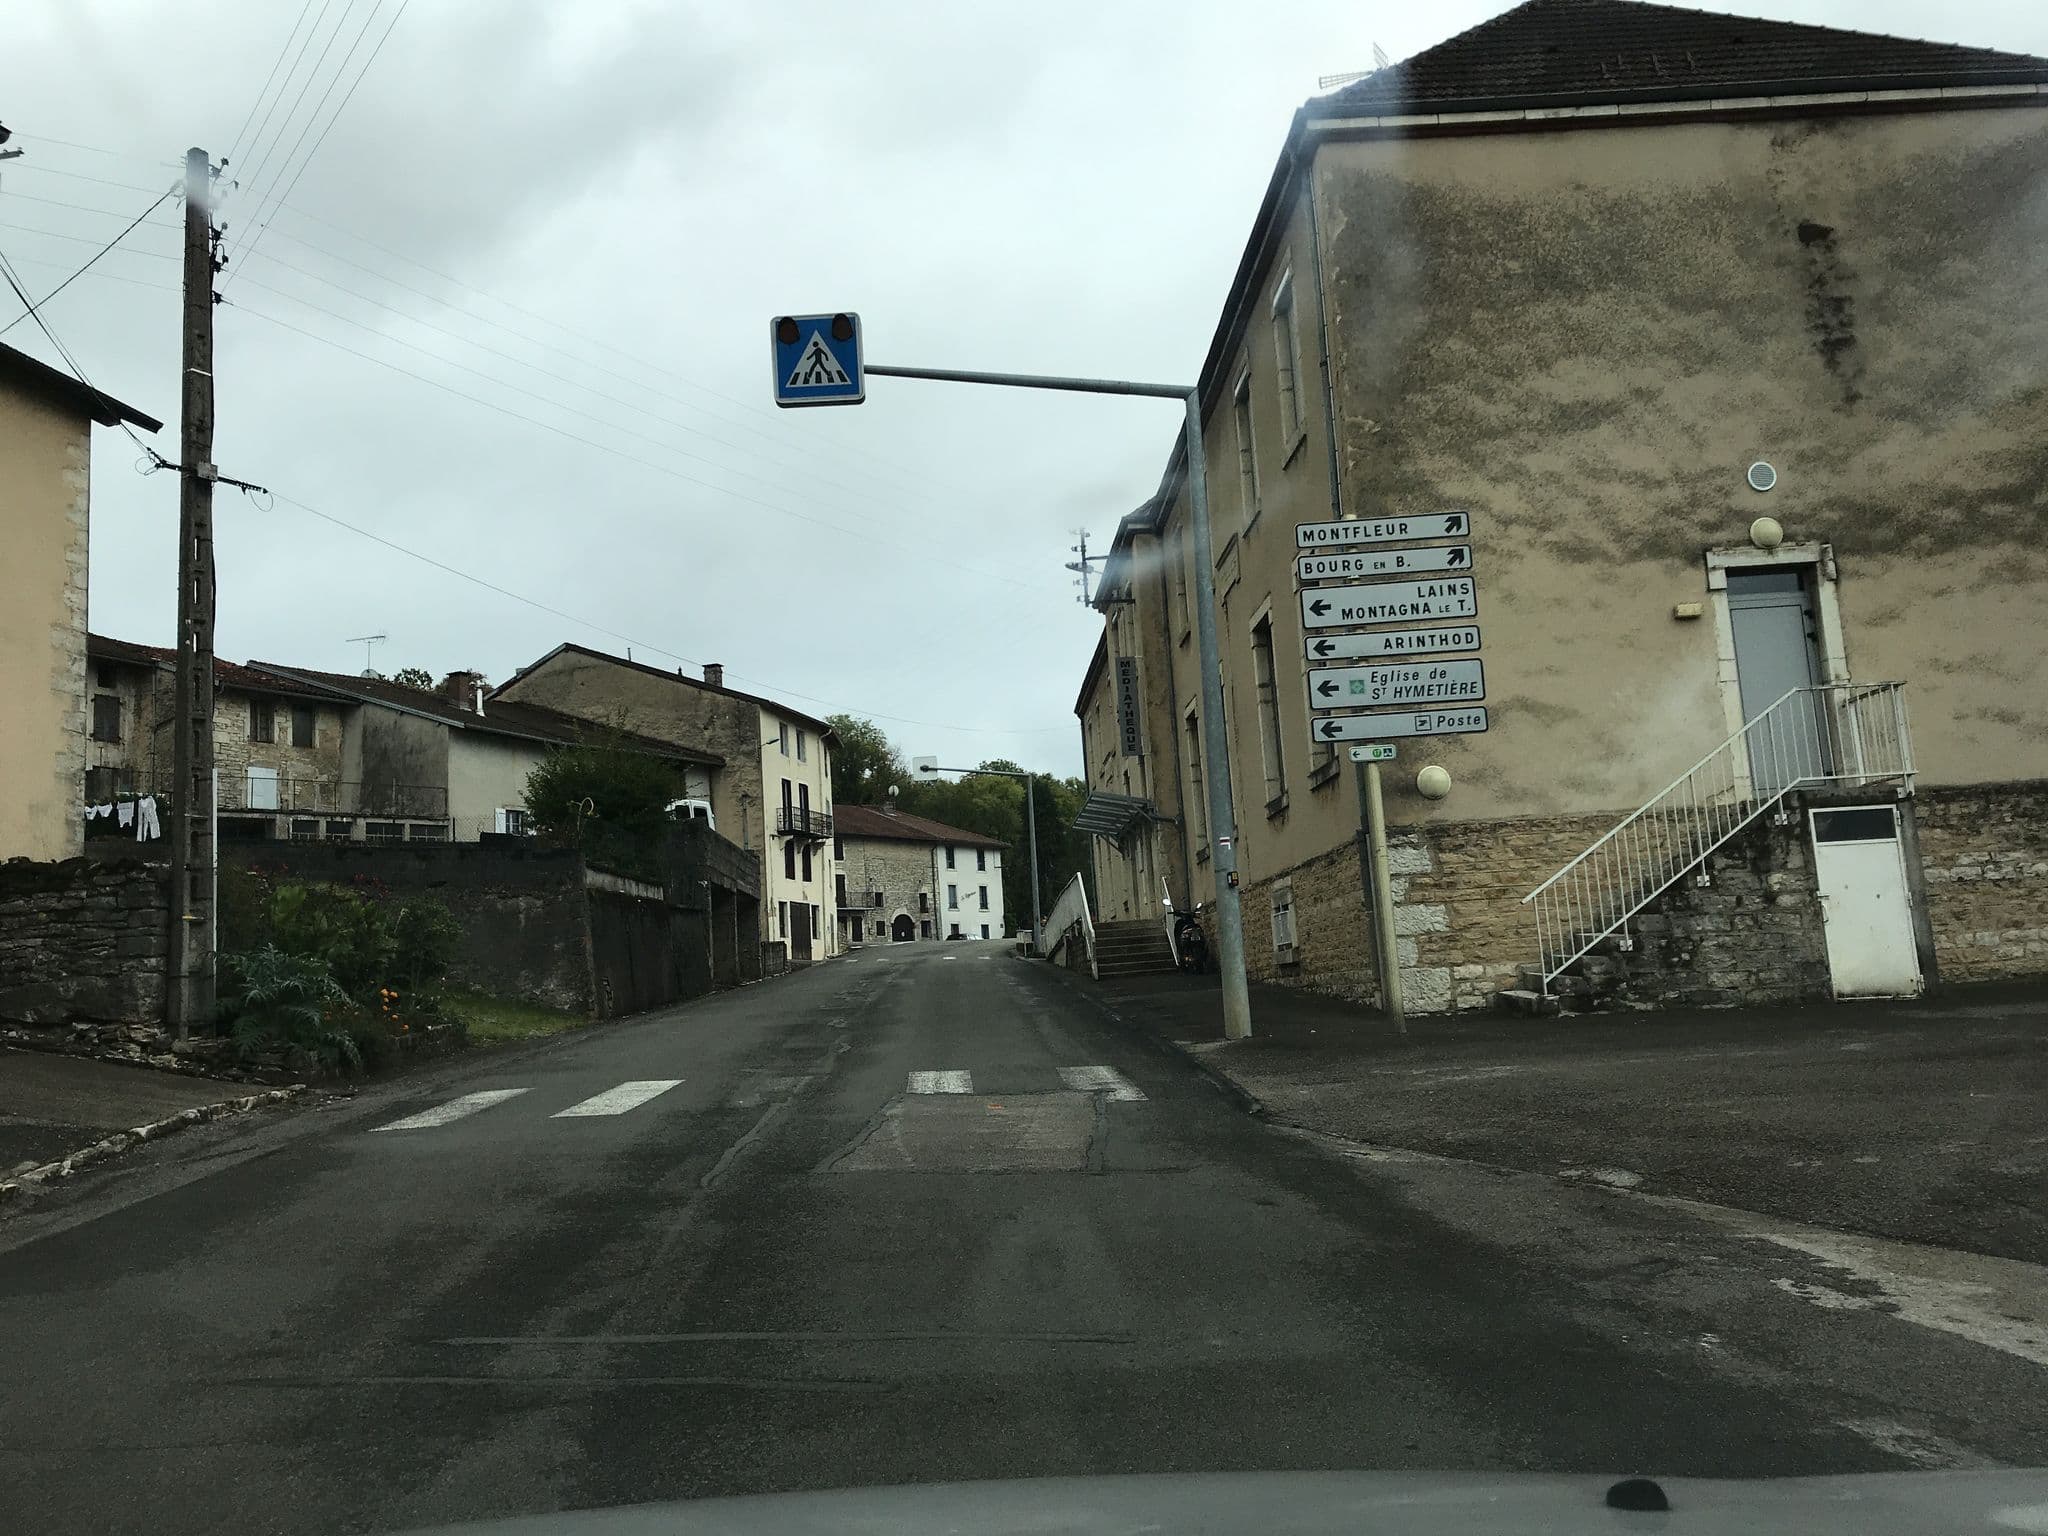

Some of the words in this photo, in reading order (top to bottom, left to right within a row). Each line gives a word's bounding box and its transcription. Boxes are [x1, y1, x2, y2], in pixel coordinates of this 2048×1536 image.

[1303, 523, 1409, 542] MONTFLEUR
[1304, 559, 1364, 574] BOURG
[1373, 561, 1386, 570] EN
[1396, 556, 1411, 568] B.
[1418, 583, 1470, 598] LAINS
[1342, 602, 1431, 620] MONTAGNA
[1439, 605, 1450, 613] LE
[1458, 600, 1471, 611] T.
[1384, 632, 1474, 650] ARINTHOD
[1371, 670, 1419, 686] Eglise
[1429, 668, 1447, 679] de
[1437, 714, 1481, 728] Poste
